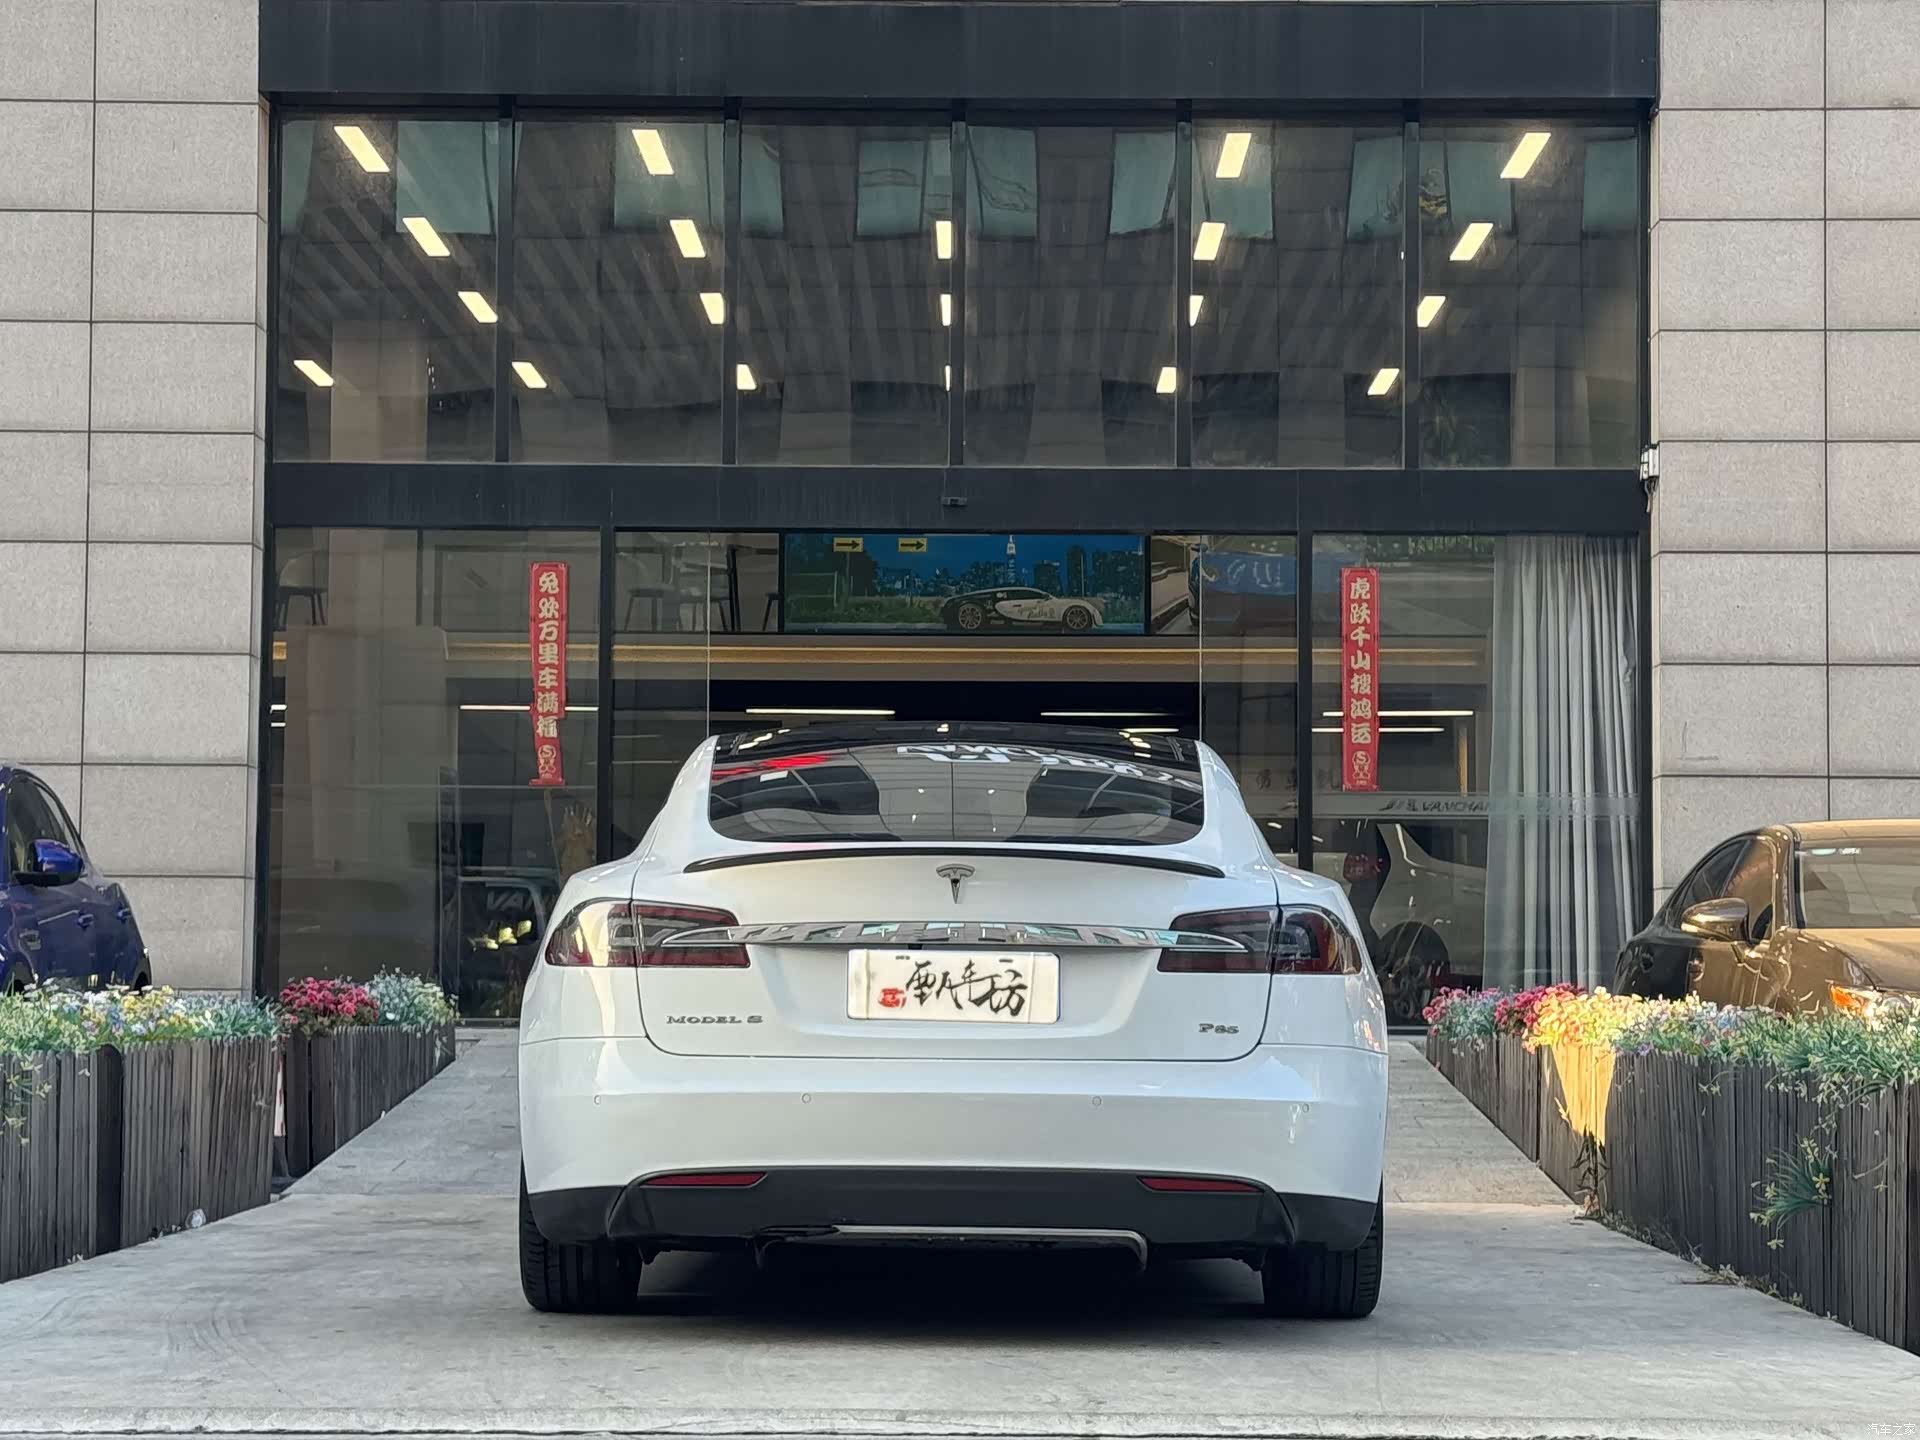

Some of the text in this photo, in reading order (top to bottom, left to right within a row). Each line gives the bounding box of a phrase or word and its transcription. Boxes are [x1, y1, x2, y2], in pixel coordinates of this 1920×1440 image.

[666, 1015, 763, 1024] MODEL S
[1198, 1023, 1239, 1034] P85
